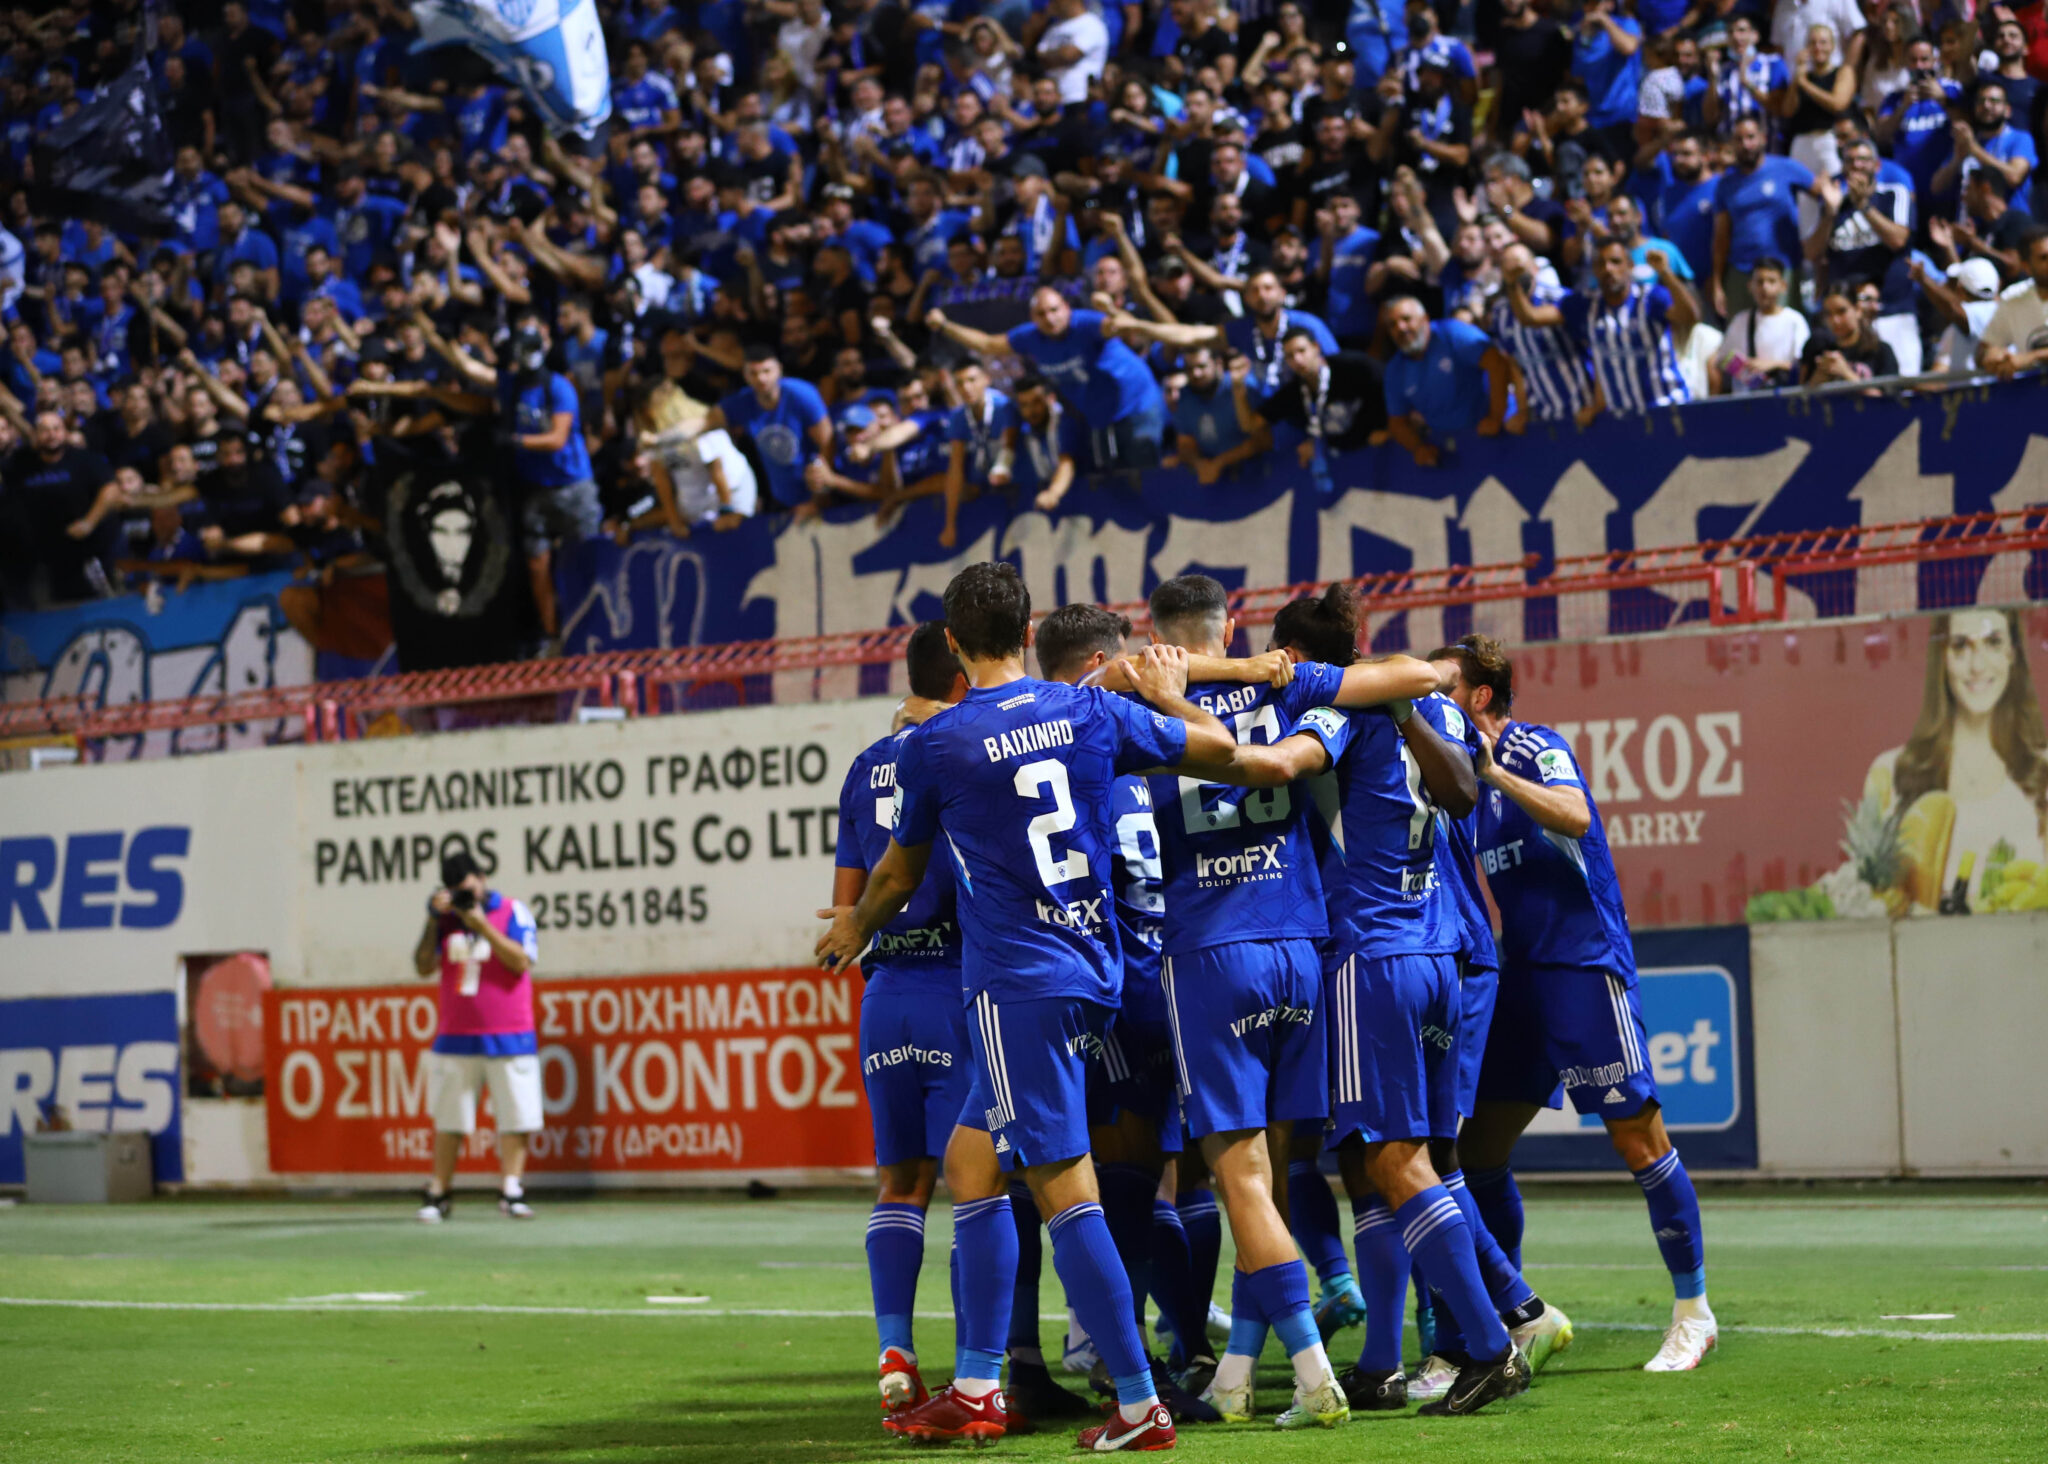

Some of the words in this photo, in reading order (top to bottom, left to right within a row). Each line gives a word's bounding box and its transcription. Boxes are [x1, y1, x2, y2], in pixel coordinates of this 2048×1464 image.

[983, 719, 1074, 763] BAIXINHO
[333, 758, 625, 819] ΕΚΤΕΛΩΝΙΣΤΙΚΟ
[647, 742, 829, 797] ΓΡΑΦΕΙΟ
[525, 818, 677, 874] KALLIS
[692, 814, 751, 864] Co
[1013, 758, 1090, 888] 2
[1602, 810, 1706, 847] ARRY
[1196, 843, 1283, 878] IronFX
[1198, 877, 1231, 888] SOLID
[1237, 872, 1283, 884] TRADING
[531, 886, 709, 931] 25561845
[540, 979, 852, 1036] ΣΤΟΙΧΗΜΑΤΩΝ
[592, 1033, 859, 1114] ΚΟΝΤΟΣ
[574, 1125, 607, 1157] 37
